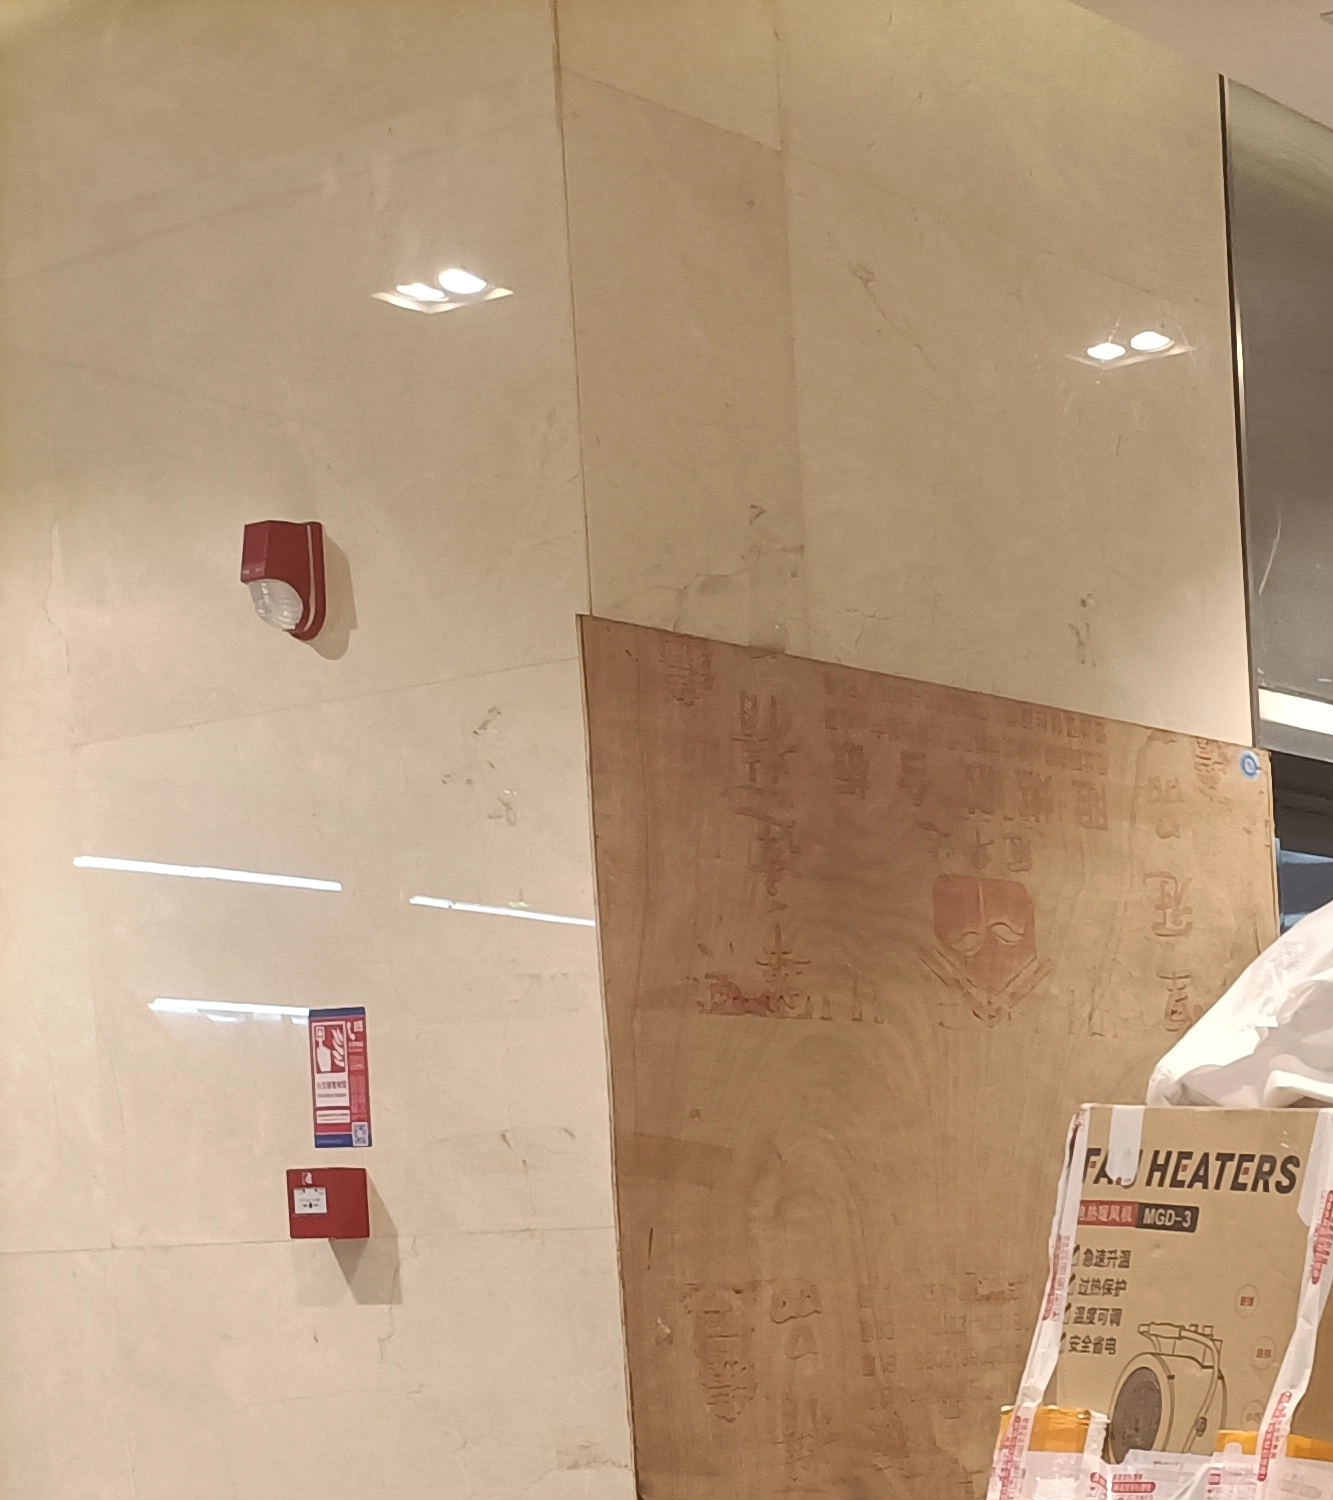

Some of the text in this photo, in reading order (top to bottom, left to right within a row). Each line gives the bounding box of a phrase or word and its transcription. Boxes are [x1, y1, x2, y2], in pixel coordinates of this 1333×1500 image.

[1145, 1149, 1301, 1195] HEATERS
[1142, 1206, 1193, 1229] MGD-3
[1082, 1248, 1132, 1269] 急速升温
[1077, 1277, 1128, 1298] 过热保护
[1073, 1306, 1123, 1327] 温度可调
[1068, 1333, 1117, 1356] 安全省电
